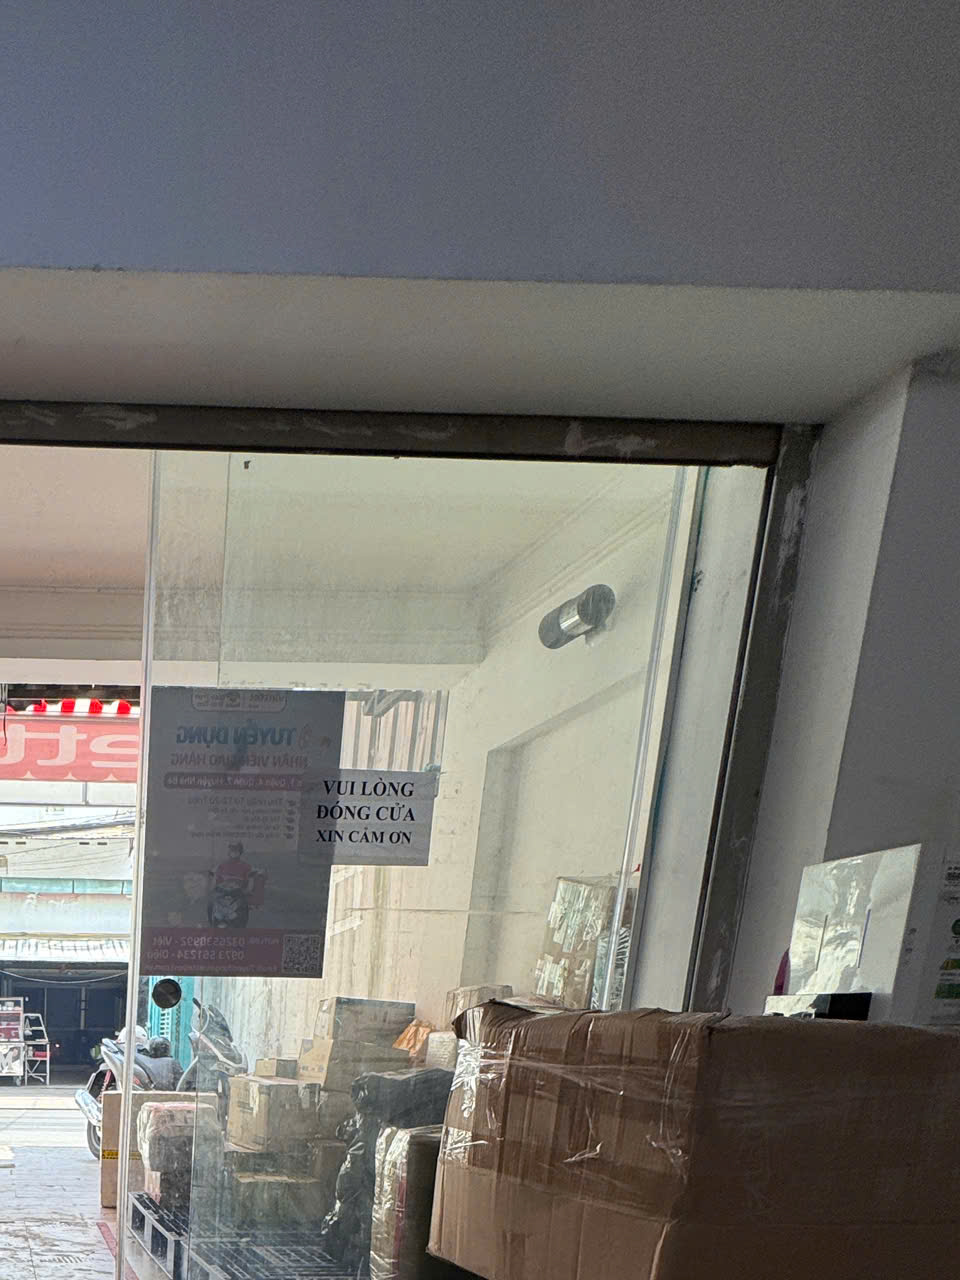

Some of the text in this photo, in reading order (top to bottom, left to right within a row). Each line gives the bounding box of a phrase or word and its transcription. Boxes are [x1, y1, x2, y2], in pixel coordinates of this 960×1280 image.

[323, 780, 356, 795] VUI
[361, 778, 415, 797] LÒNG
[316, 801, 416, 821] ĐÓNG CỬA
[316, 827, 412, 844] XIN CẢM ƠN
